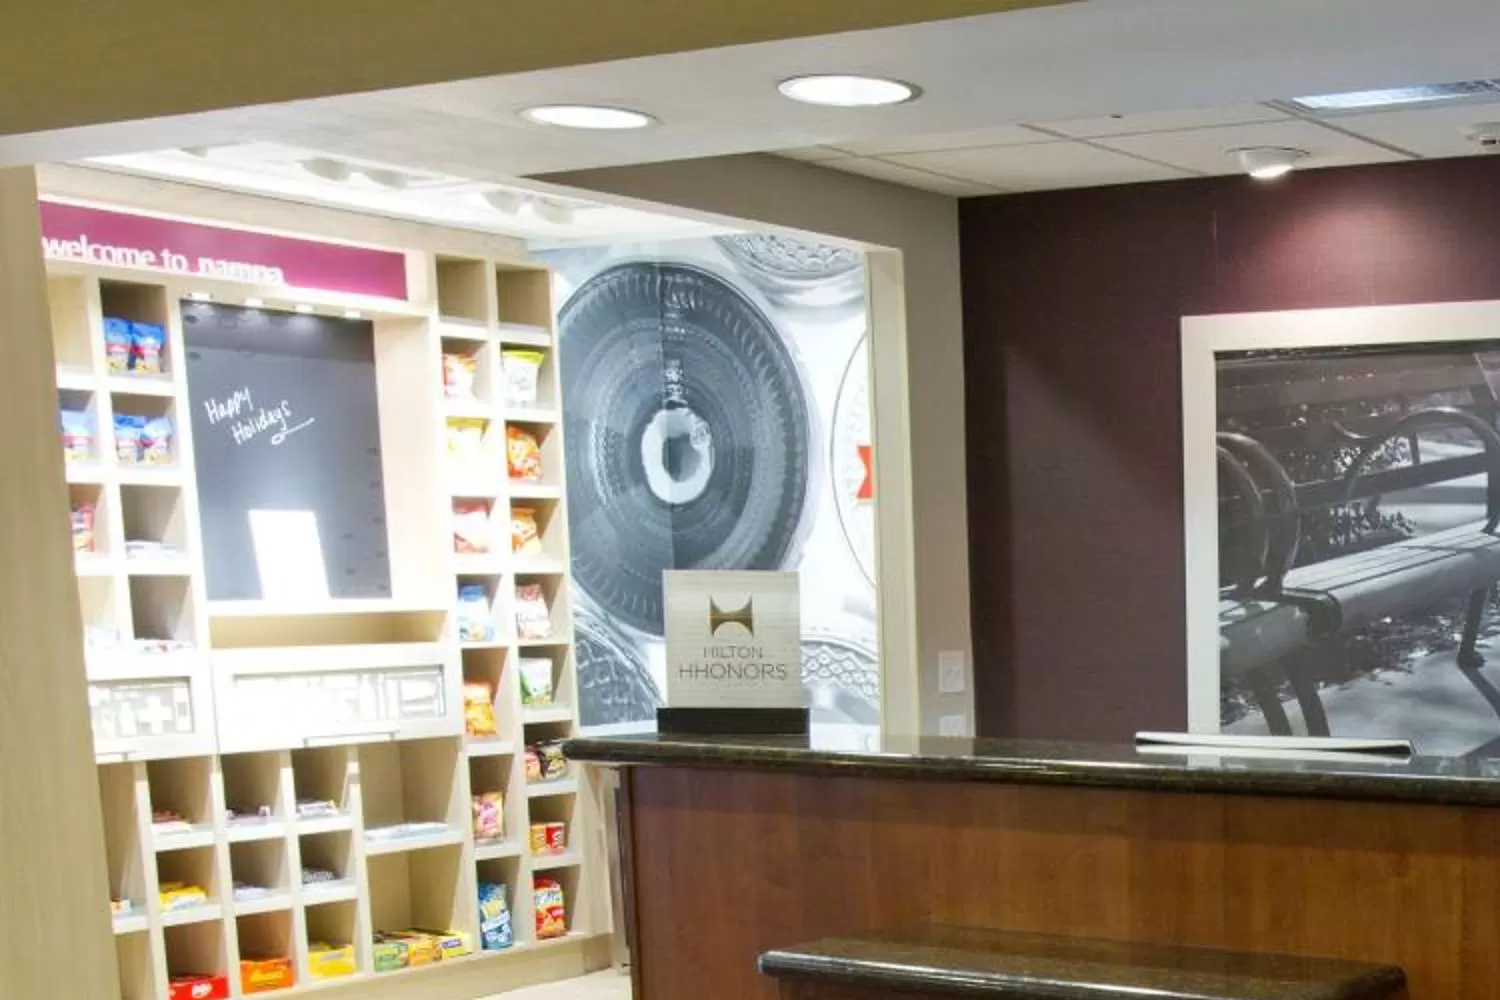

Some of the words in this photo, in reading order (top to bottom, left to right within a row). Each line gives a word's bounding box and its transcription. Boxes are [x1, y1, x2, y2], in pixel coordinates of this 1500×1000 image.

[41, 234, 156, 268] welcome
[160, 248, 188, 273] to
[203, 385, 254, 425] Happy
[231, 399, 293, 445] Holidays
[679, 662, 788, 681] HHONORS
[702, 645, 764, 660] HILTON
